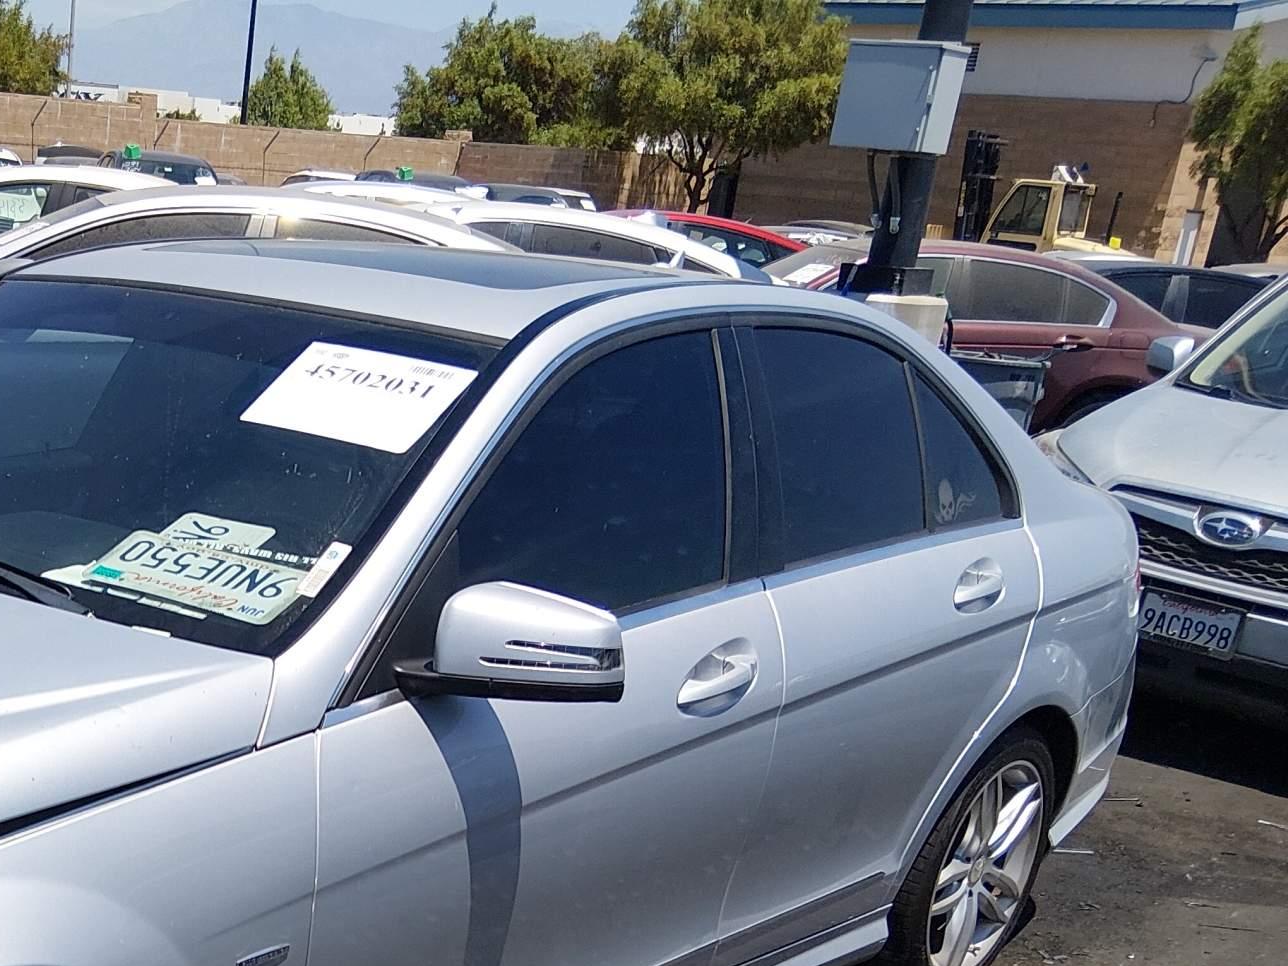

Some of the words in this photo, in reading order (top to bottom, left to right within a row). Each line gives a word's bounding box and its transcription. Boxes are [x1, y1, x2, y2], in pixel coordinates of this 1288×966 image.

[305, 363, 435, 399] 45702031
[119, 540, 298, 599] 9NUE550
[125, 571, 239, 611] California
[237, 605, 266, 619] JUN
[1140, 607, 1232, 650] 9ACB998
